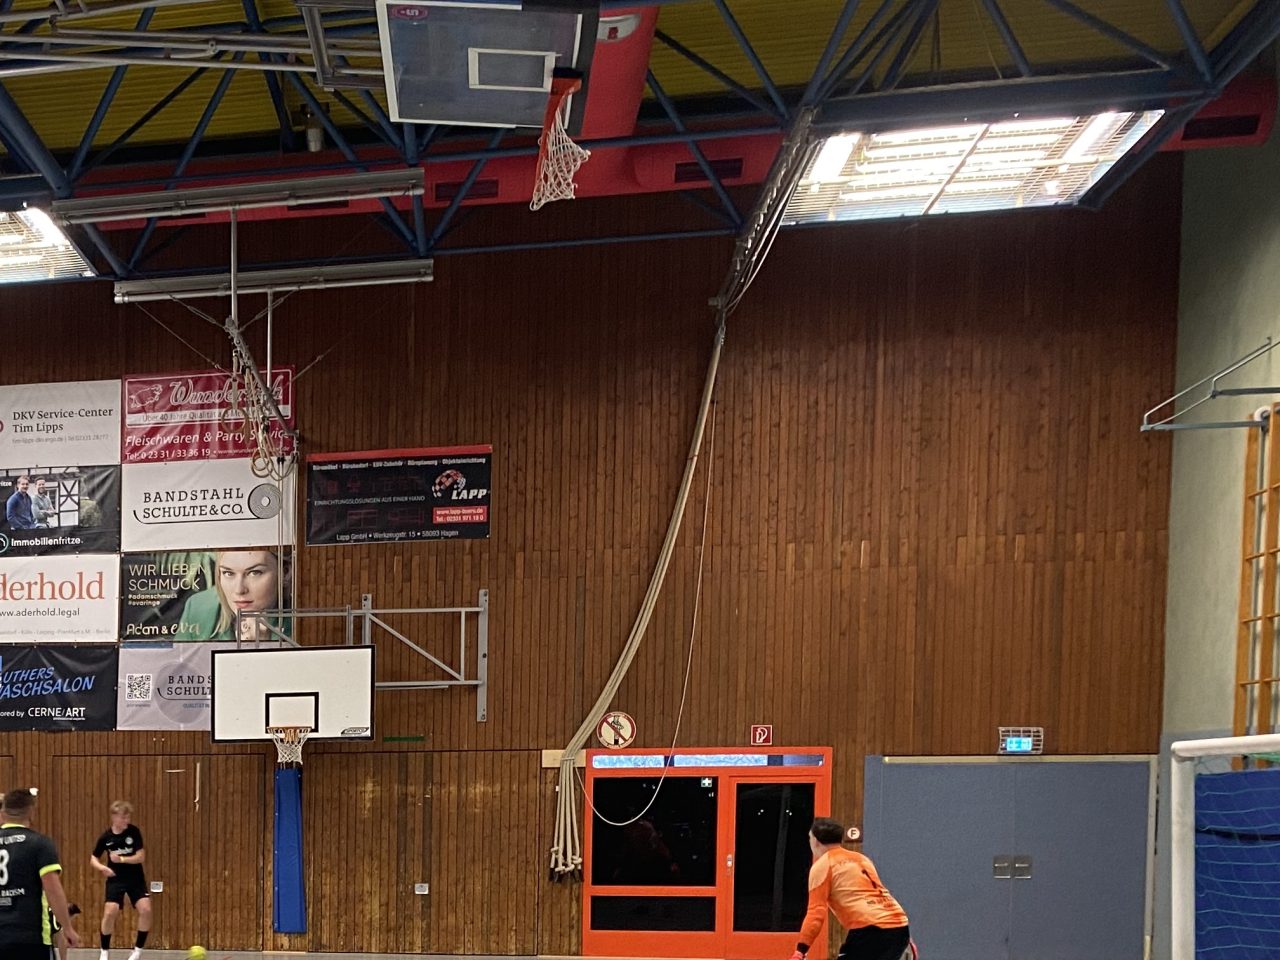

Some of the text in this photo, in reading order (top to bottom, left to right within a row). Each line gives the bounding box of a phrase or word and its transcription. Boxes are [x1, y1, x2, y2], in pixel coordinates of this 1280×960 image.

[170, 375, 283, 406] Wunderh
[13, 408, 114, 421] DKV Service-Center
[13, 422, 64, 433] Tim Lipps
[125, 432, 199, 447] Fleischwaren
[203, 432, 212, 442] &
[215, 430, 245, 444] Party
[149, 451, 159, 459] 23
[161, 450, 170, 458] 31
[143, 488, 244, 503] BANDSTAHL
[452, 489, 488, 500] LAPP
[143, 504, 244, 518] SCHULTE&CO.
[129, 563, 205, 576] WIR LIEBEN
[128, 578, 201, 591] SCHMUCK
[127, 622, 200, 636] Adam & eva
[16, 710, 25, 719] by
[28, 707, 86, 717] CERNE/ART
